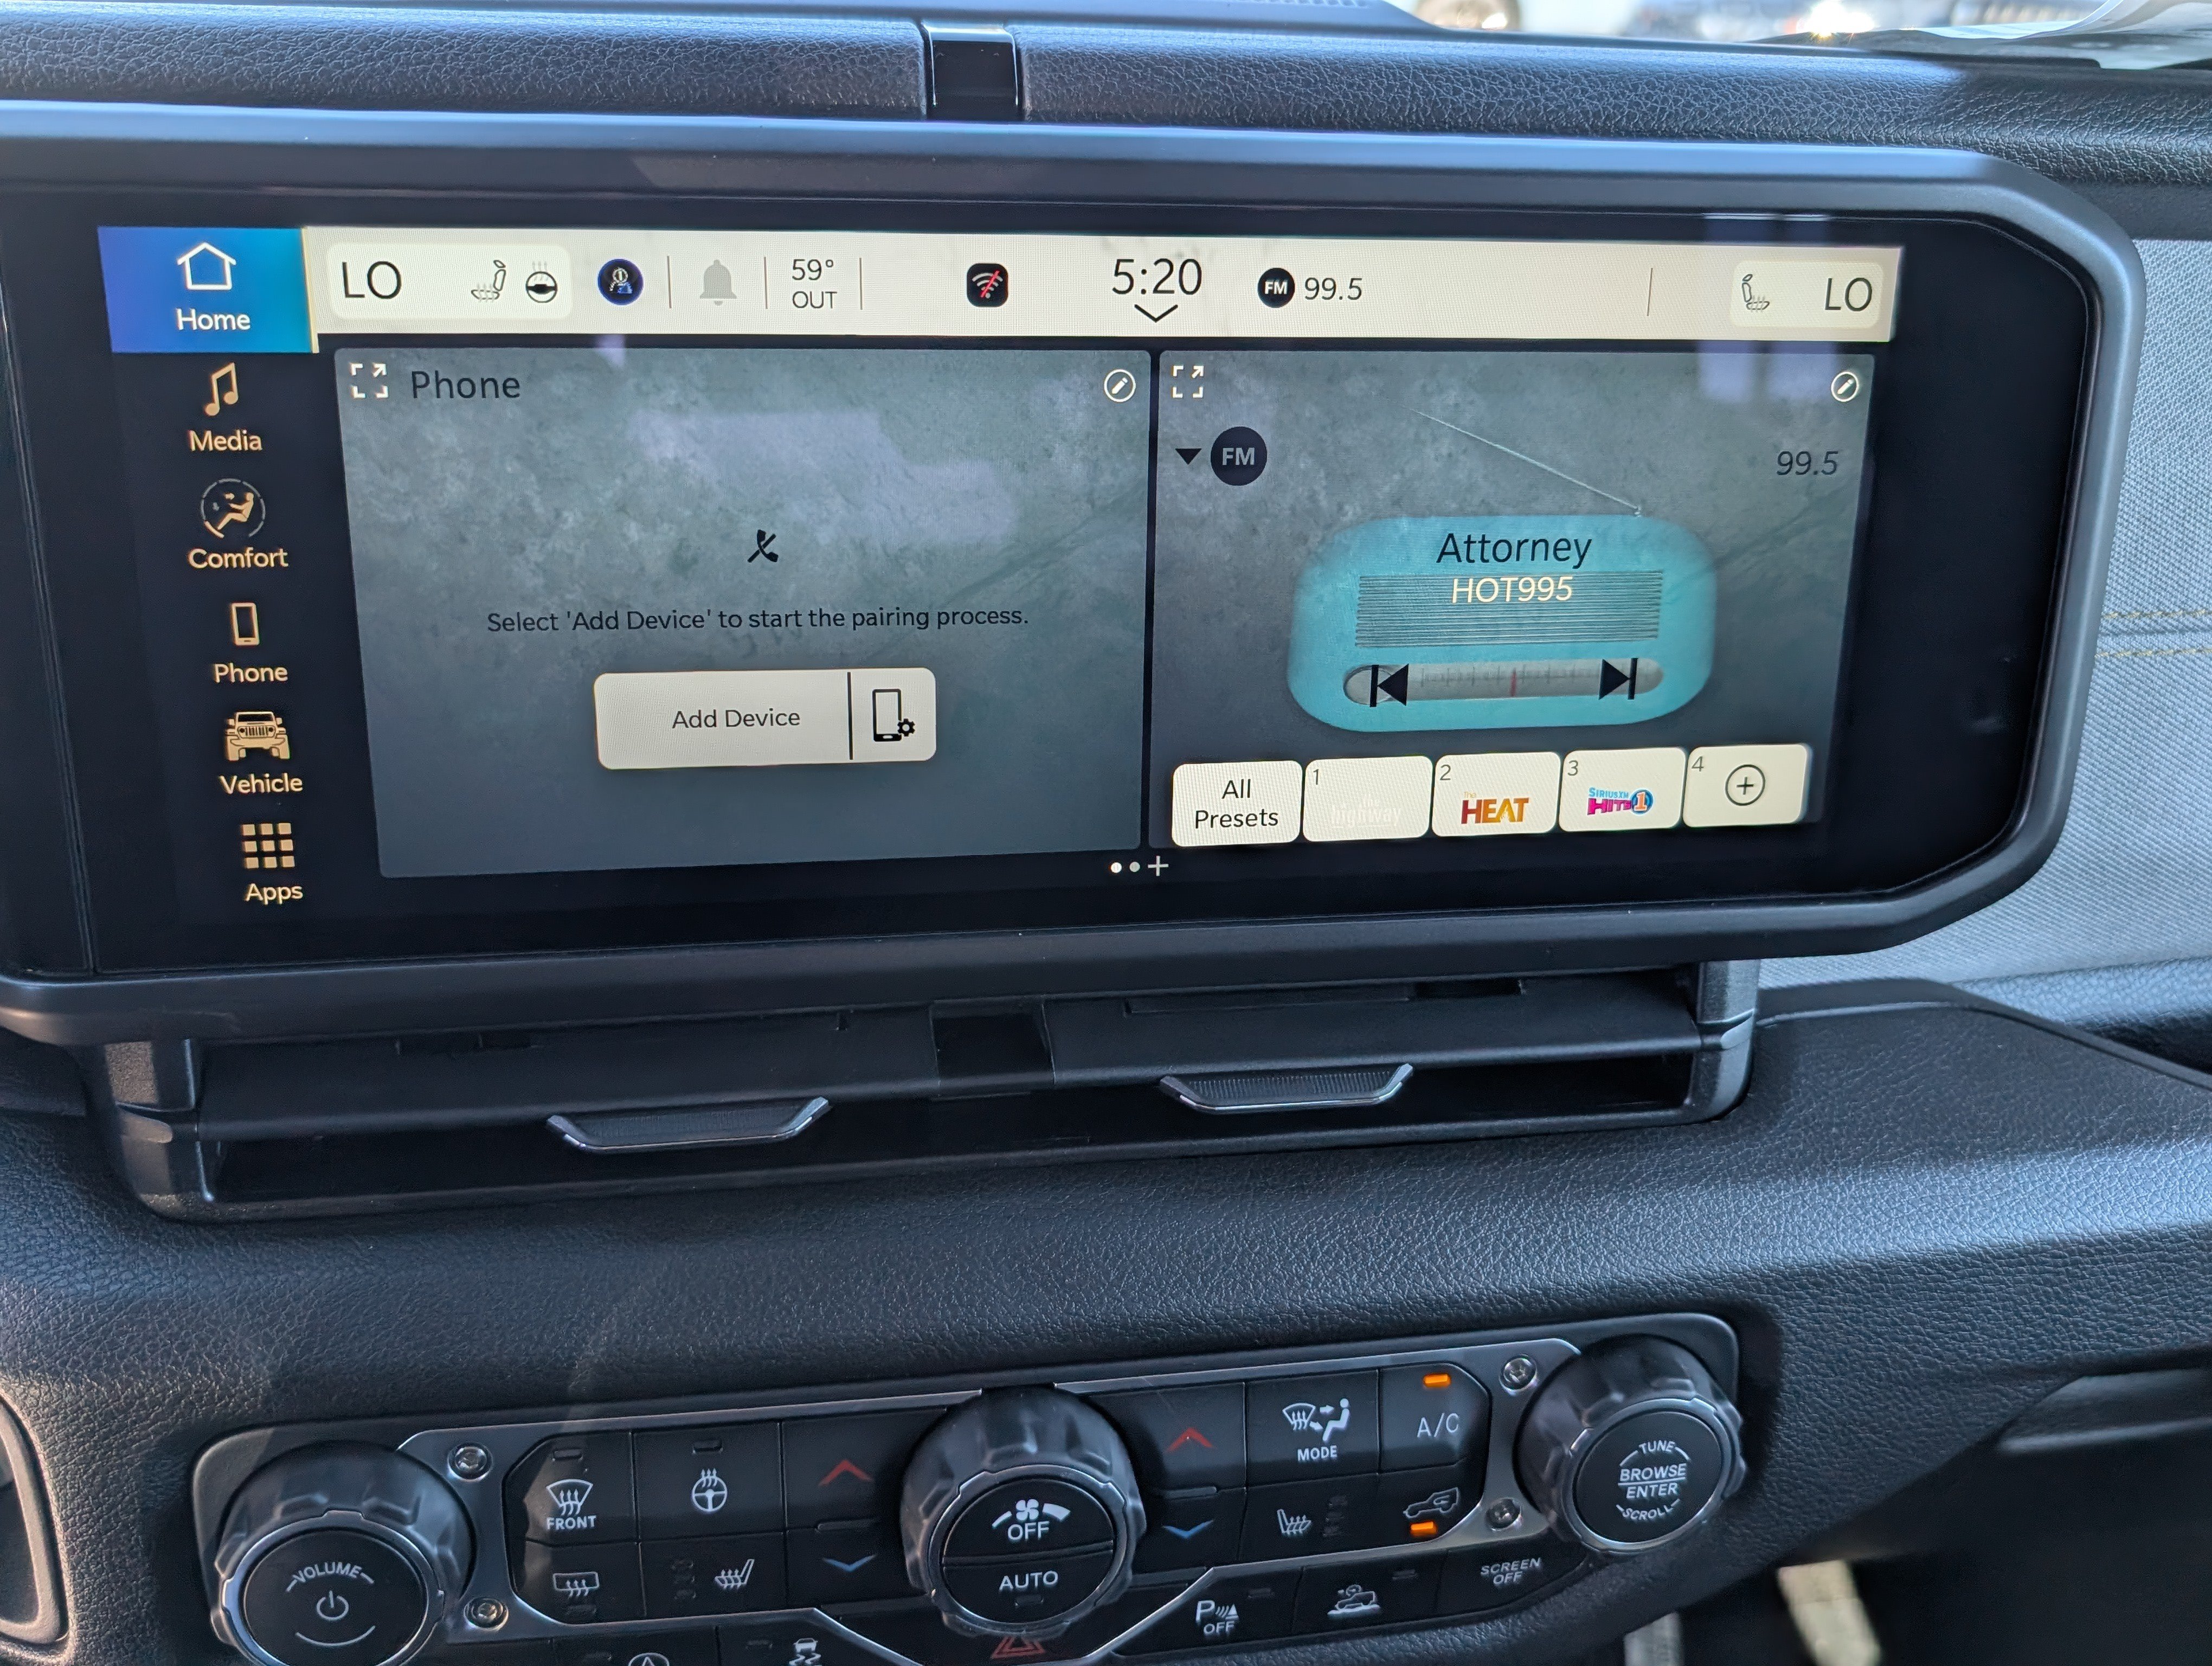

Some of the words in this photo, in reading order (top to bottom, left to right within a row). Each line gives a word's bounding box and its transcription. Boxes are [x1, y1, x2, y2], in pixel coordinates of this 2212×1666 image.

[342, 260, 402, 299] LO
[1112, 258, 1202, 295] 5:20
[1264, 280, 1288, 294] FM
[1304, 278, 1362, 300] 99.5
[1824, 277, 1873, 311] LO
[793, 291, 837, 309] OUT
[176, 308, 250, 330] Home
[411, 371, 521, 399] Phone
[189, 430, 262, 451] Media
[1221, 447, 1255, 466] FM
[1777, 451, 1839, 475] 99.5
[188, 547, 288, 569] Comfort
[1437, 533, 1592, 568] Attorney
[1451, 576, 1573, 604] HOT995
[487, 612, 558, 632] Select
[718, 611, 742, 629] to
[748, 610, 802, 628] start
[808, 607, 845, 627] the
[852, 606, 930, 631] pairing
[937, 610, 1029, 630] process.
[214, 663, 288, 683] Phone
[672, 709, 717, 729] Add
[725, 708, 800, 728] Device
[1439, 765, 1451, 780] 2
[1567, 760, 1579, 776] 3
[1691, 756, 1704, 771] 4
[220, 773, 303, 794] Vehicle
[1313, 768, 1320, 785] 1
[1222, 779, 1251, 799] All
[1195, 809, 1278, 829] Presets
[1461, 798, 1529, 824] HEAT
[245, 883, 303, 905] Apps
[1417, 1413, 1459, 1438] A/C
[1297, 1445, 1338, 1461] MODE
[1639, 1440, 1676, 1454] TUNE
[1619, 1463, 1687, 1481] BROWSE
[1626, 1482, 1677, 1500] ENTER
[547, 1515, 596, 1530] FRONT
[1622, 1505, 1671, 1521] SCROLL
[1007, 1521, 1049, 1541] OFF
[294, 1562, 362, 1583] VOLUME
[1481, 1558, 1541, 1575] SCREEN
[999, 1571, 1058, 1592] AUTO
[1493, 1571, 1522, 1587] OFF
[1196, 1600, 1215, 1623] P
[1204, 1621, 1235, 1635] OFF
